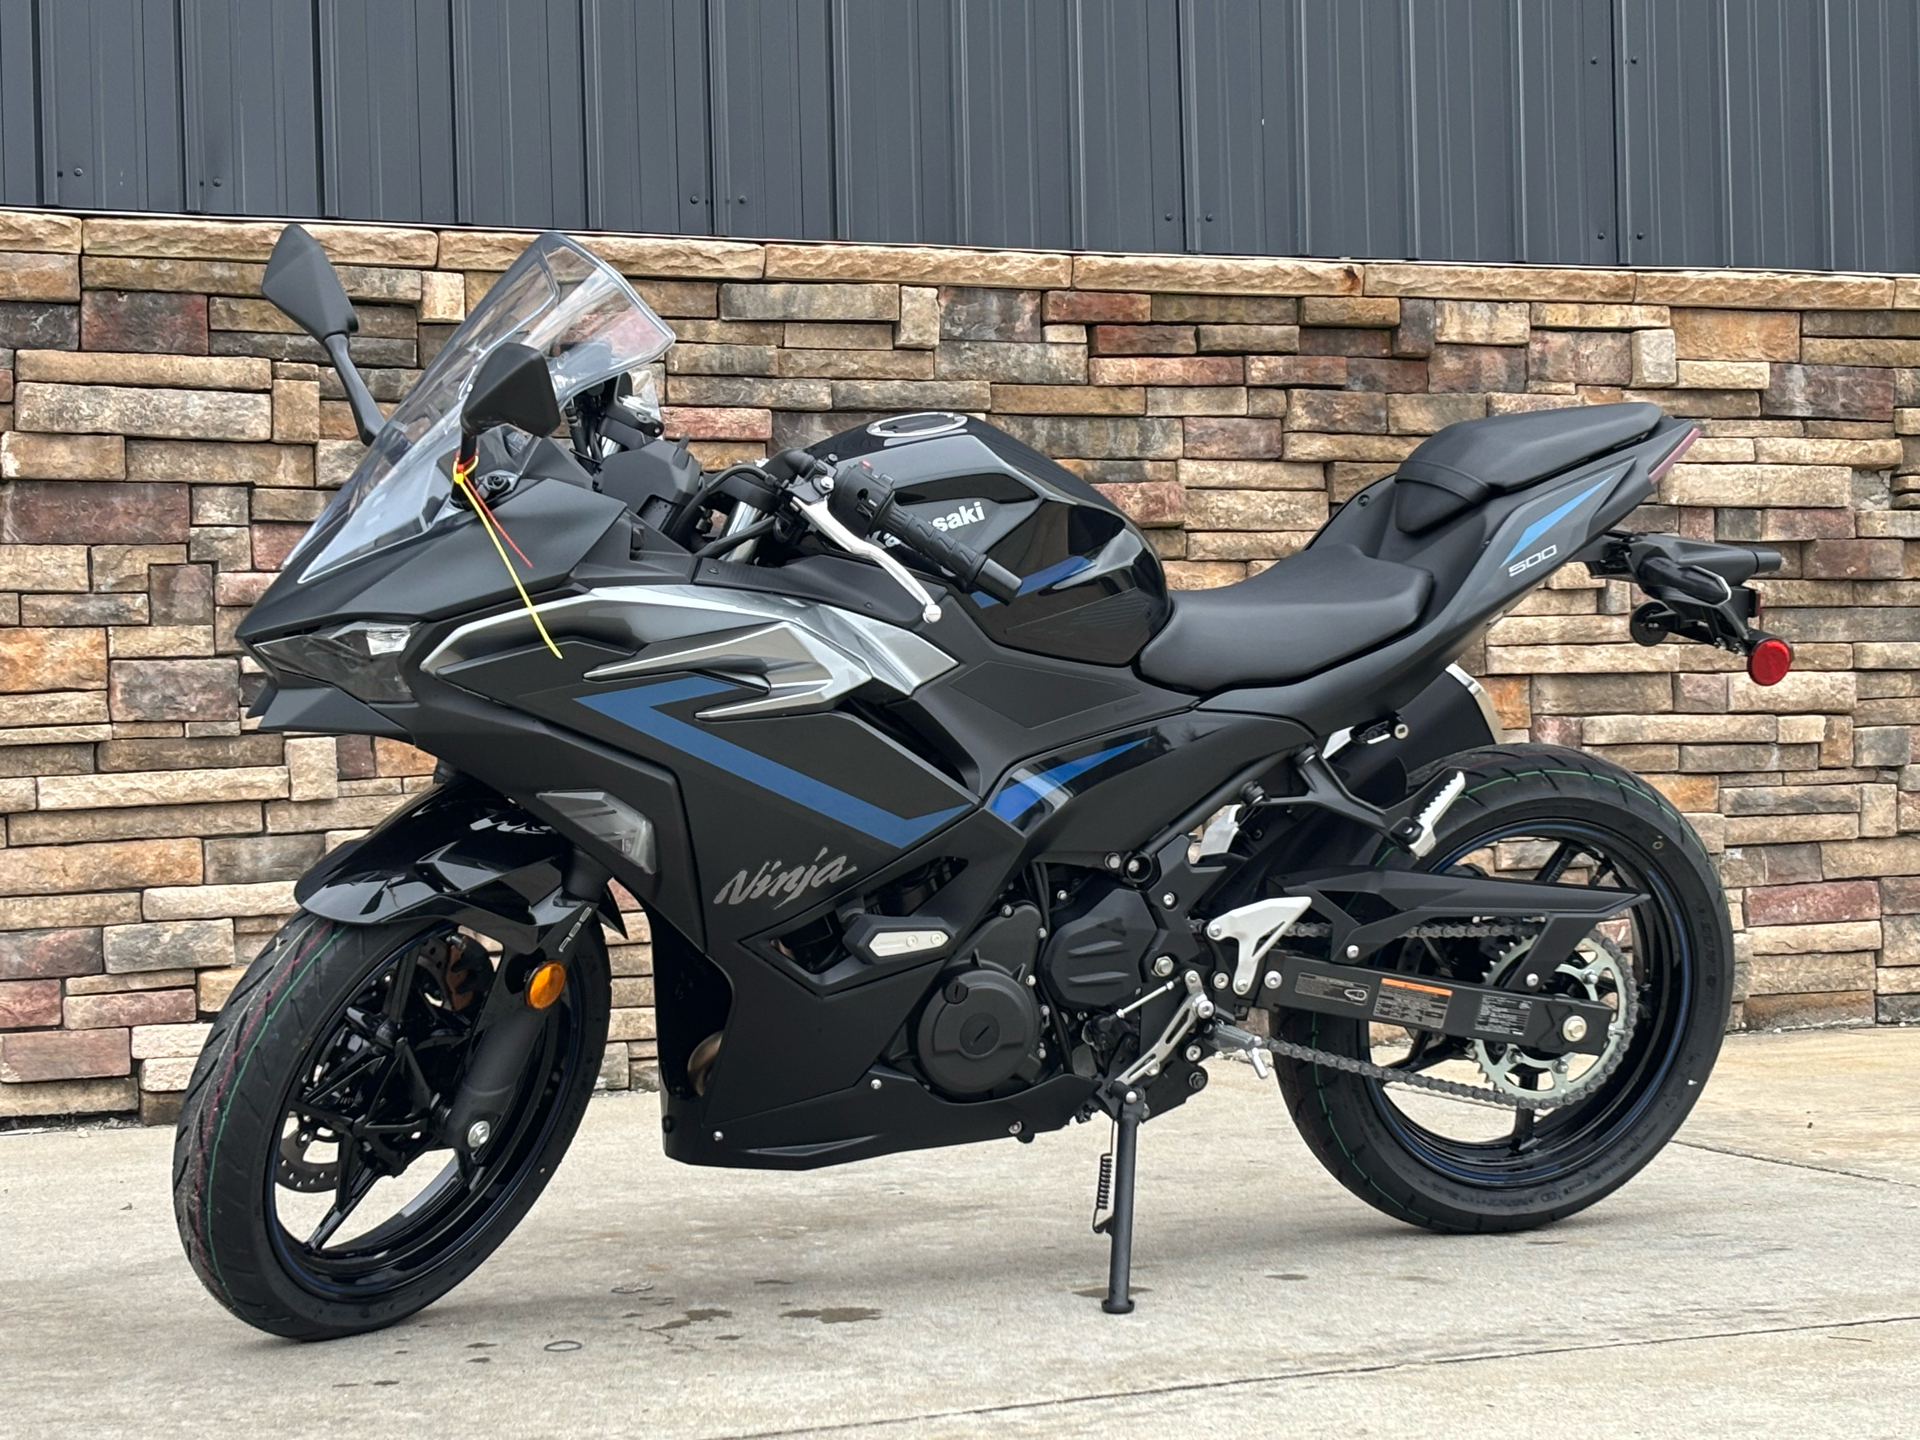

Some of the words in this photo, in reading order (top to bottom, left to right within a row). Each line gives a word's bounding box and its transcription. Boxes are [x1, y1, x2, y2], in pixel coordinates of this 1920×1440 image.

[864, 501, 986, 550] Kasaki
[1508, 544, 1558, 577] 500
[713, 847, 857, 910] Ninja
[558, 906, 592, 953] ABS
